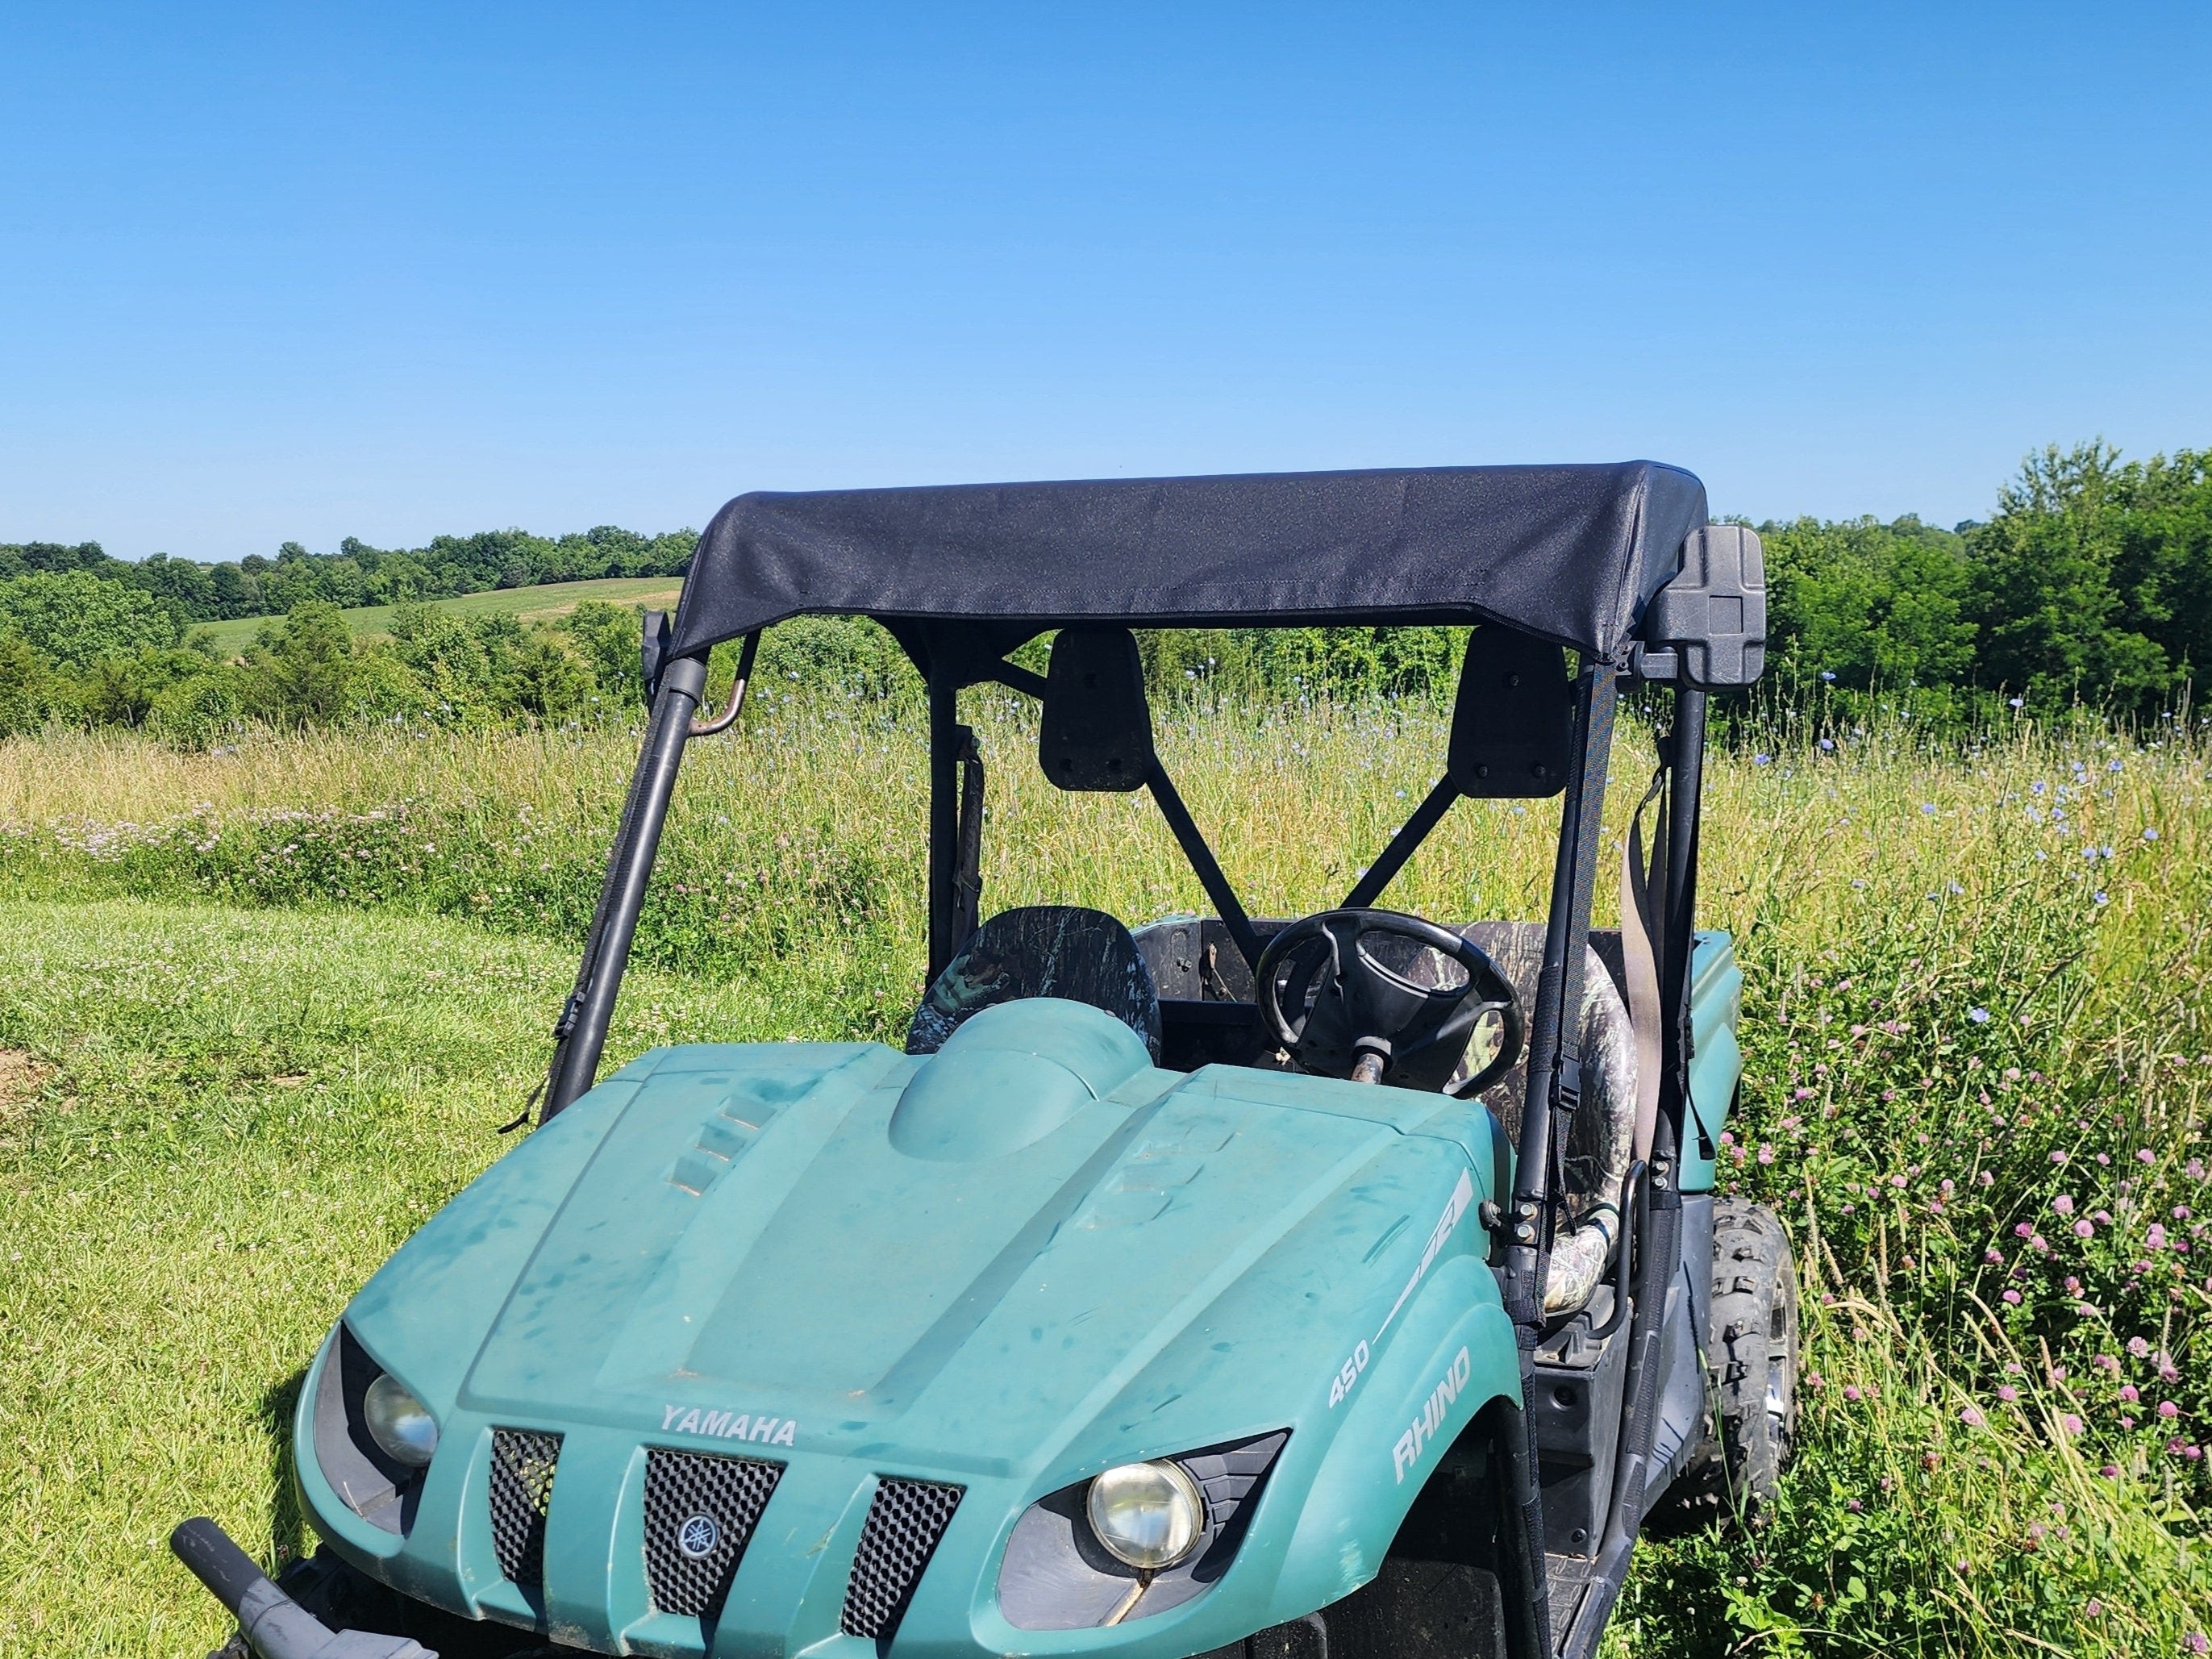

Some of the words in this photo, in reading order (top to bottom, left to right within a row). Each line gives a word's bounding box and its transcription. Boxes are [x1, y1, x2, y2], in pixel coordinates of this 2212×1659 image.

[1329, 1339, 1369, 1409] 450
[661, 1405, 797, 1446] YAMAHA
[1393, 1346, 1471, 1485] RHINO
